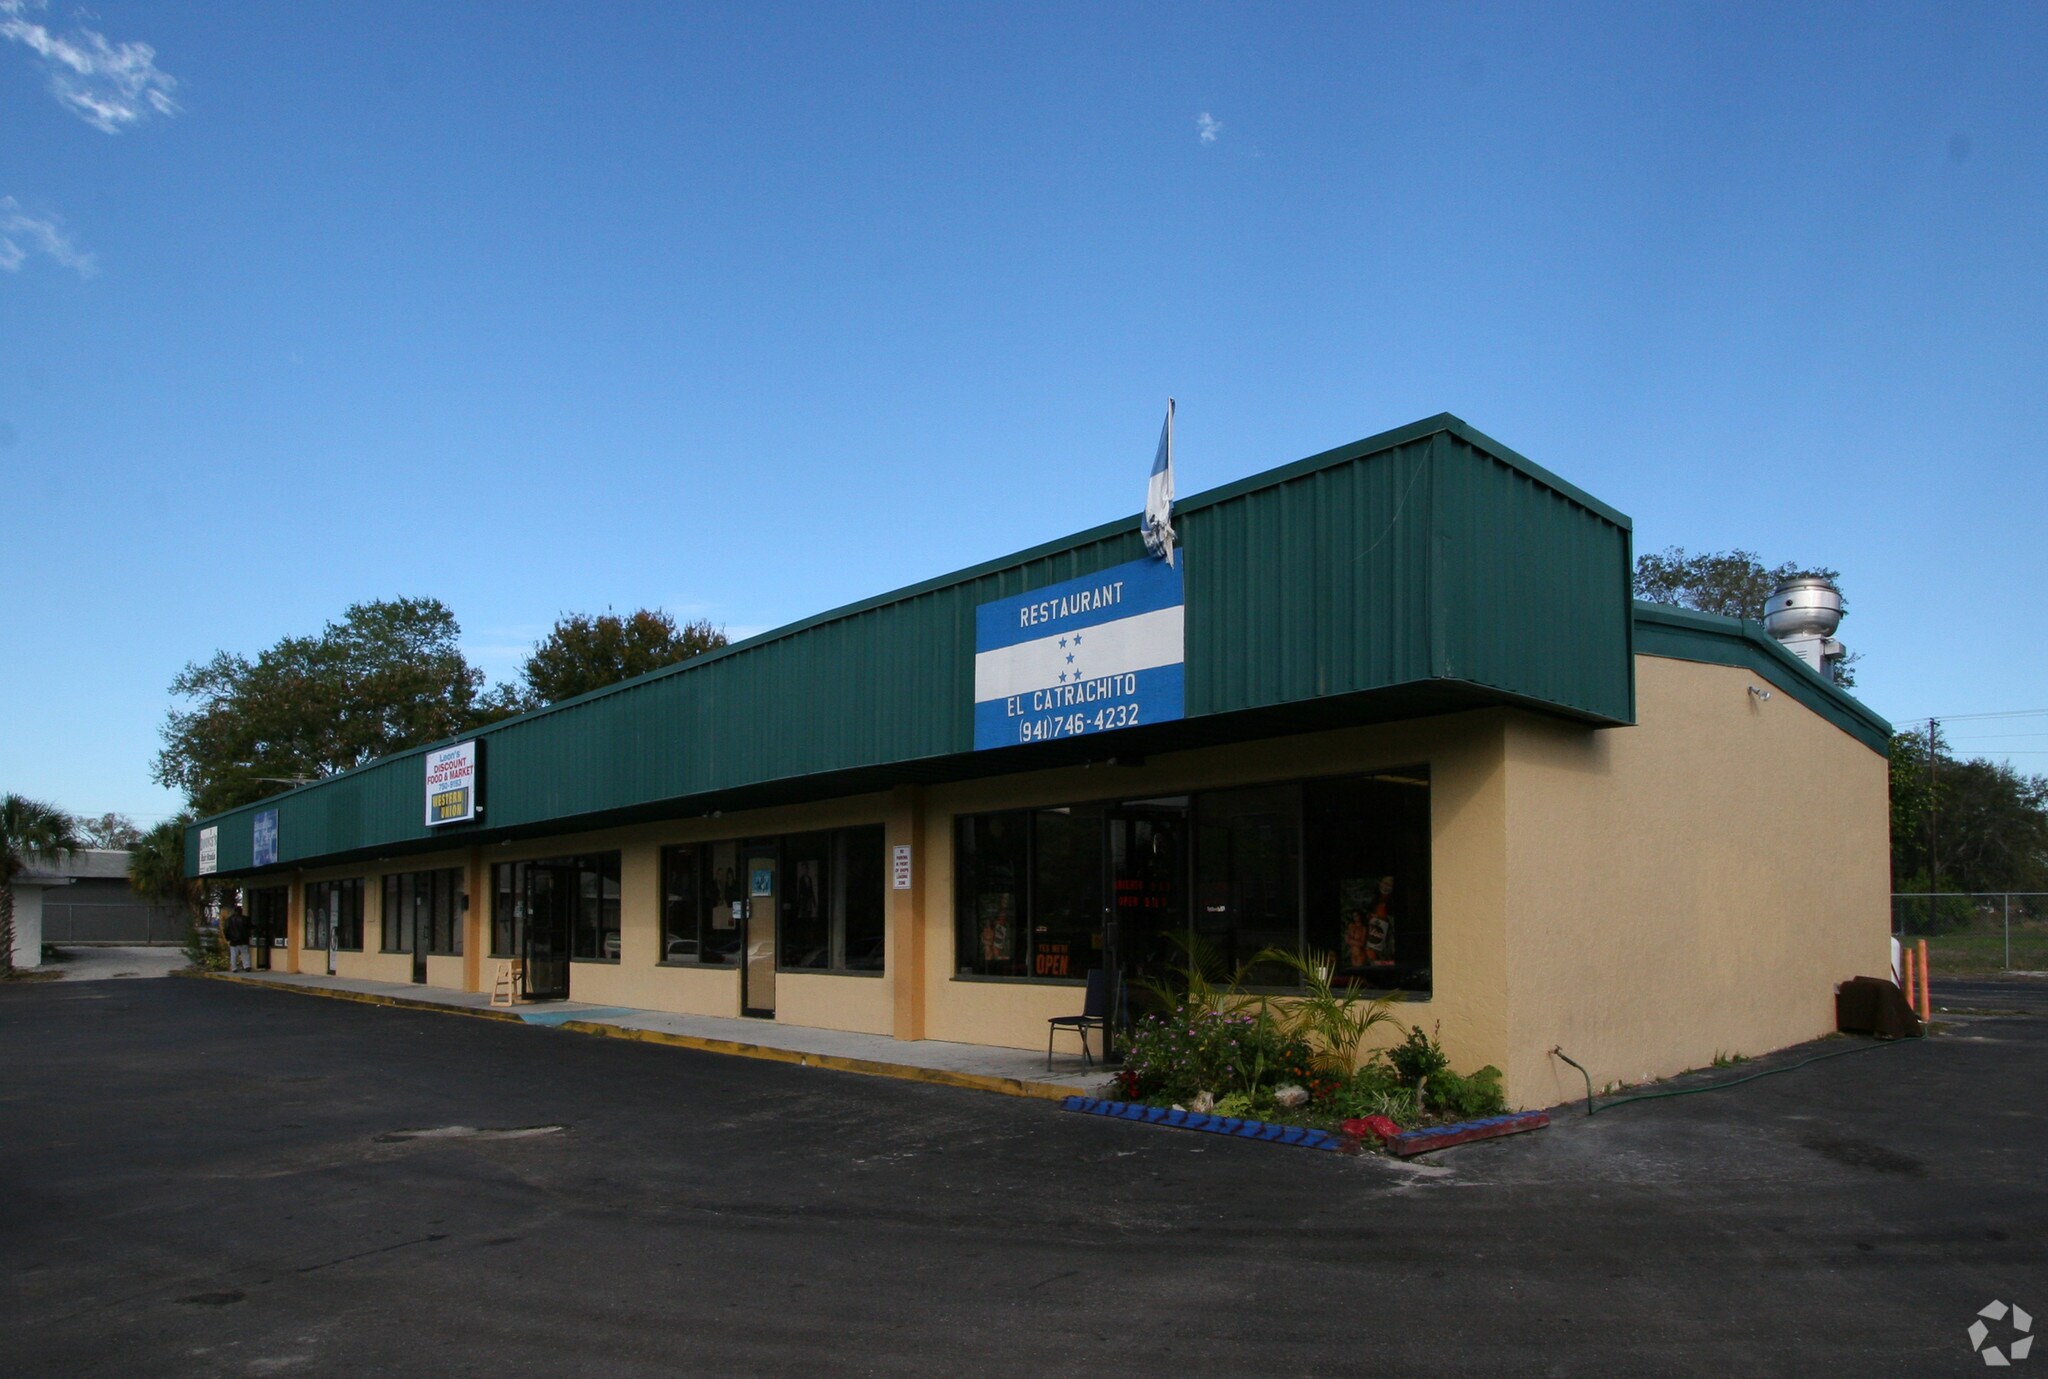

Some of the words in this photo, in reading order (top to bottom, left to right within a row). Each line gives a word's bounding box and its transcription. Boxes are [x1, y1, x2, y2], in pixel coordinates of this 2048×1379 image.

[1020, 581, 1124, 628] RESTAURANT
[1007, 697, 1025, 717] EL
[1033, 673, 1136, 711] CATRACHITO
[1019, 703, 1139, 743] (941)746-4232
[427, 774, 443, 785] FOOD
[444, 772, 448, 781] &
[450, 765, 474, 779] MARKET
[434, 757, 467, 773] DISCOUNT
[432, 790, 464, 807] WESTERN
[441, 804, 463, 818] UNION
[1036, 954, 1068, 975] OPEN
